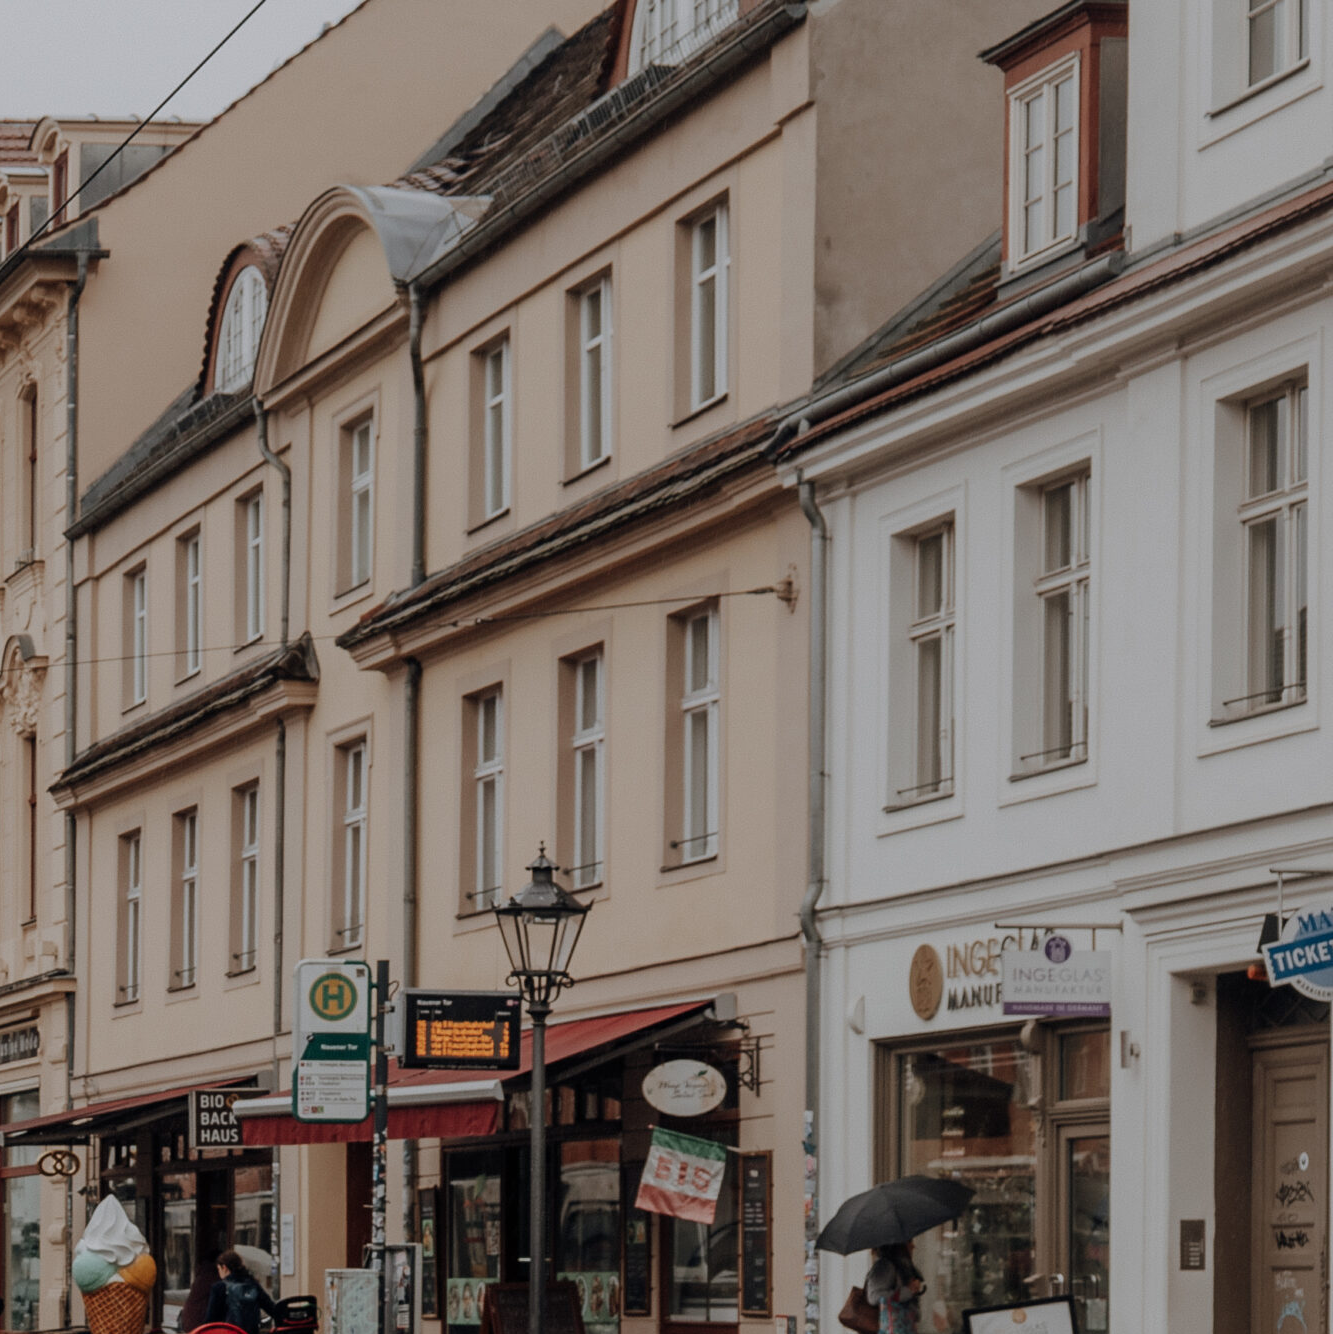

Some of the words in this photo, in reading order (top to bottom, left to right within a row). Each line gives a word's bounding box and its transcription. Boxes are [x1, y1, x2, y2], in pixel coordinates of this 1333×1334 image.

[1298, 908, 1333, 936] MA
[323, 984, 344, 1010] H
[200, 1094, 225, 1108] BIO
[200, 1111, 237, 1125] BACK
[201, 1128, 239, 1143] HAUS
[655, 1154, 711, 1193] EIS
